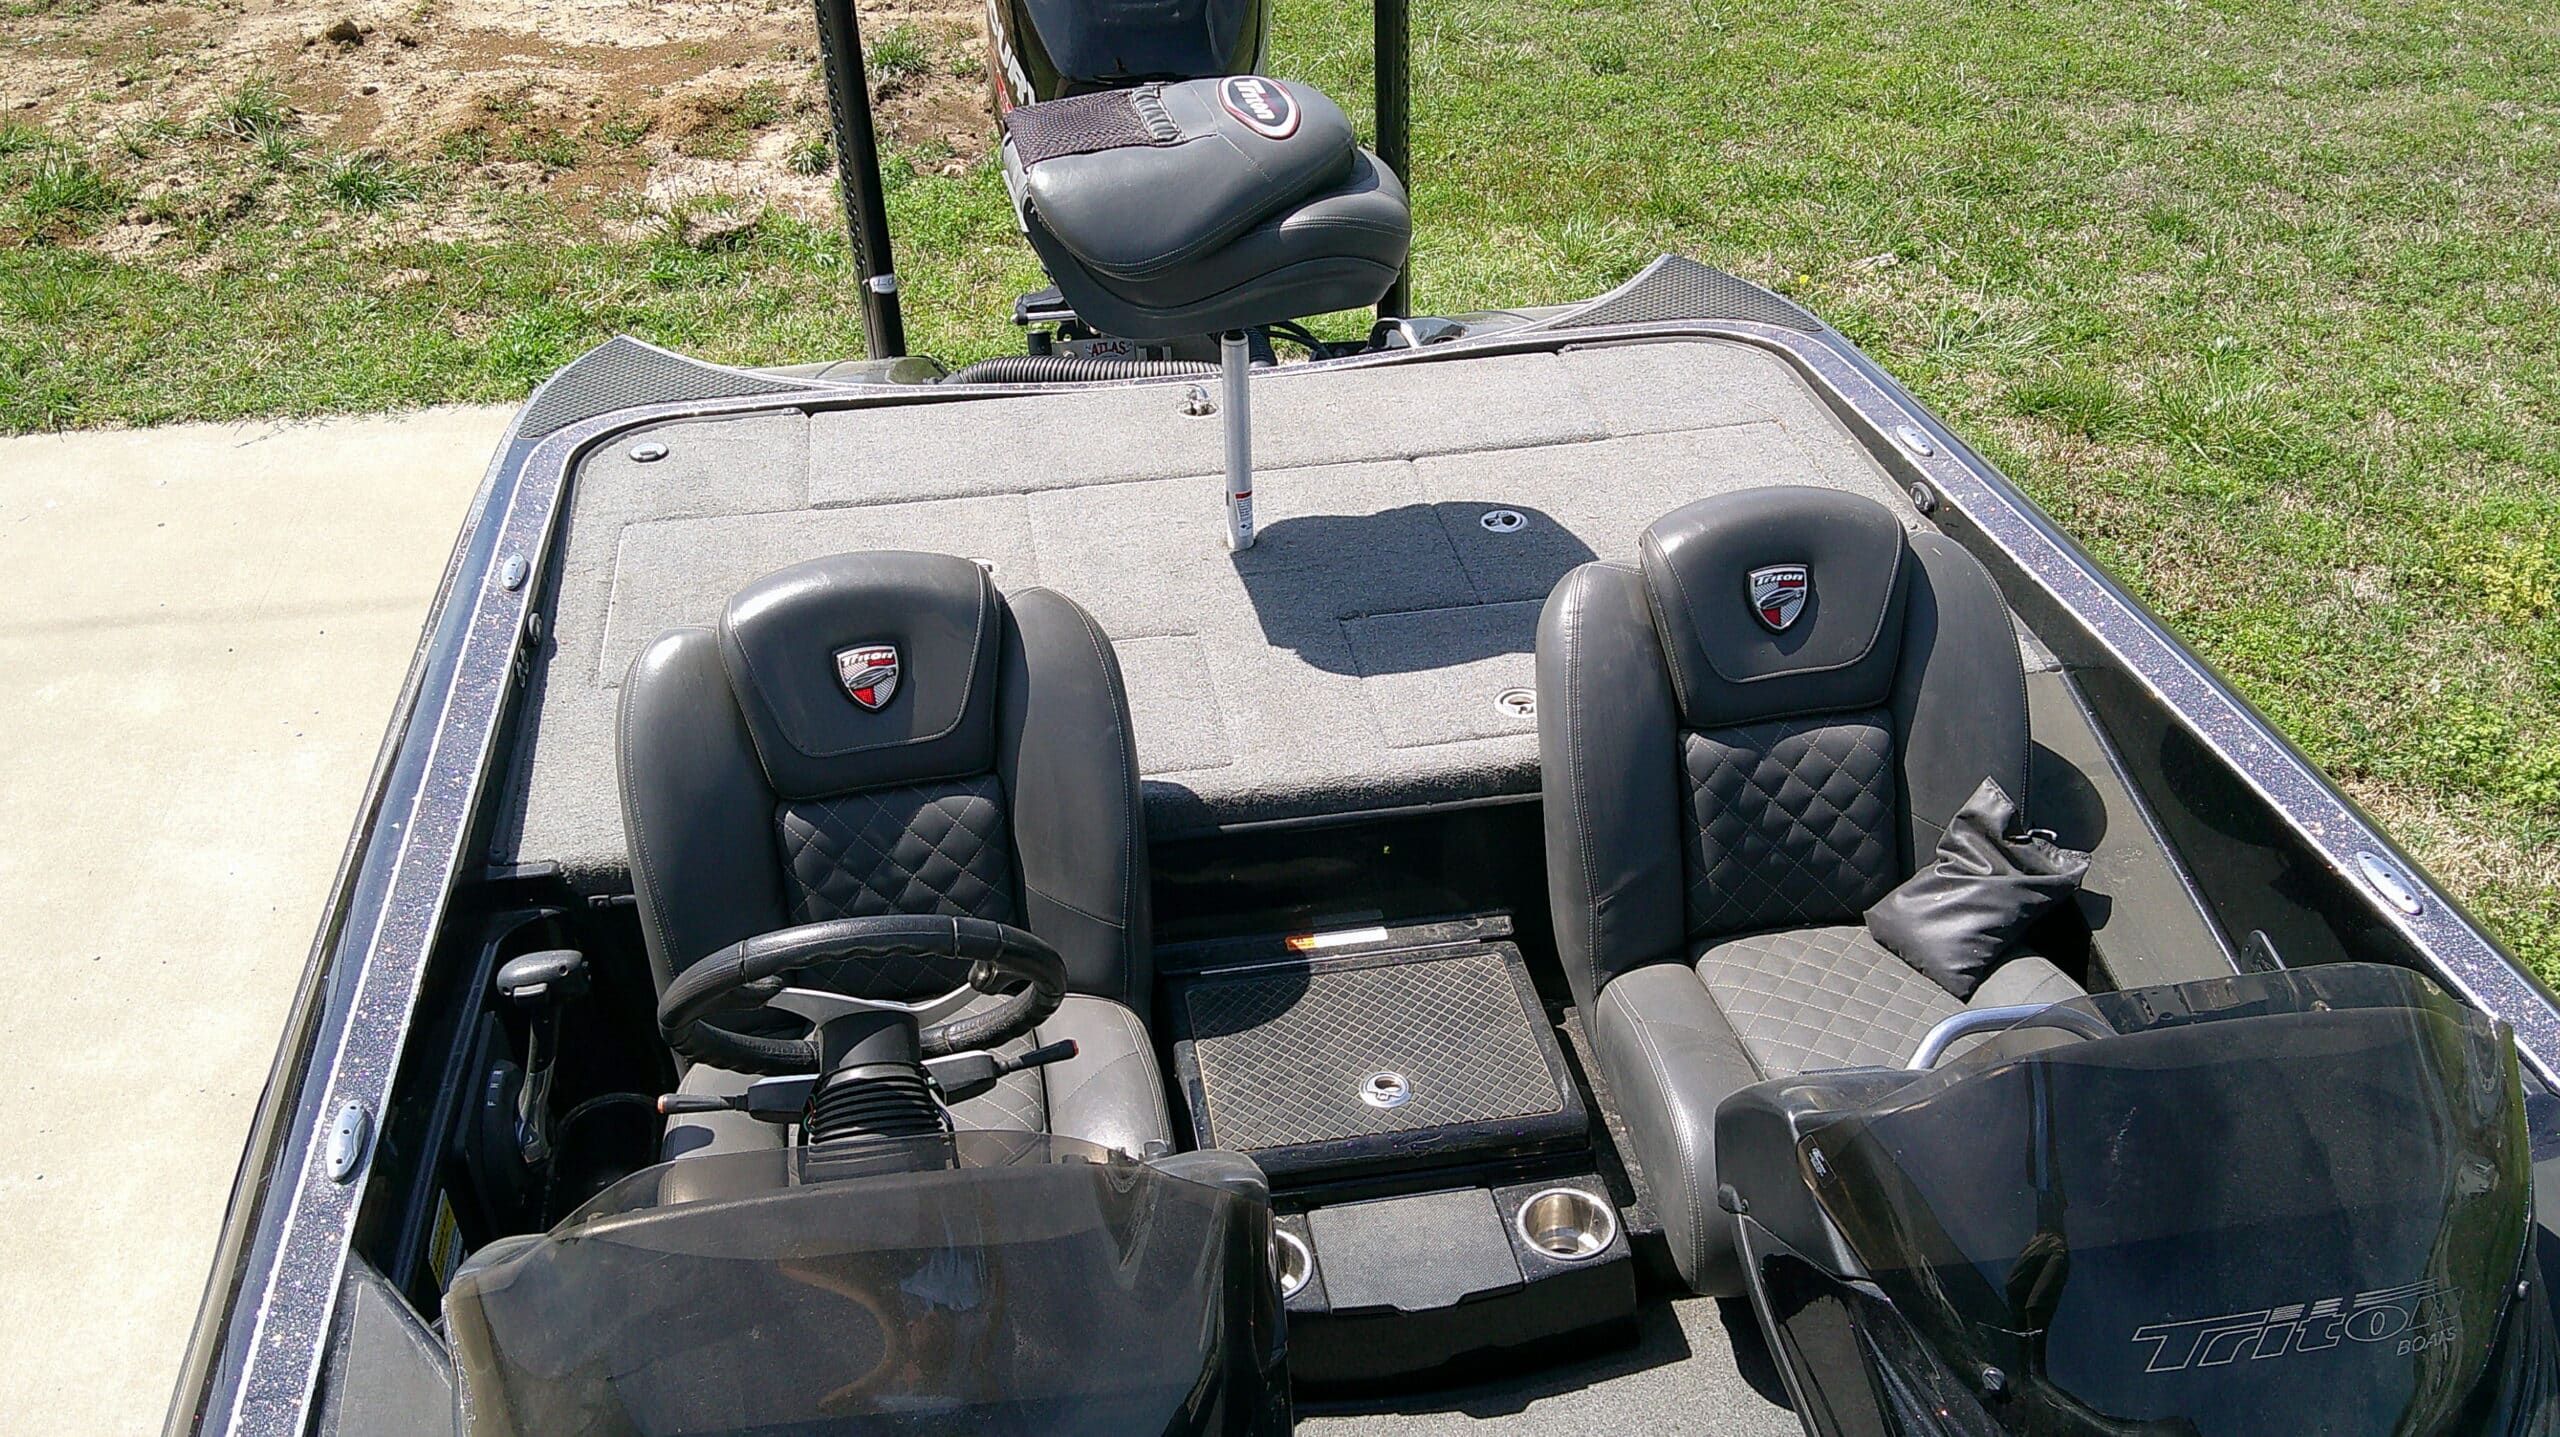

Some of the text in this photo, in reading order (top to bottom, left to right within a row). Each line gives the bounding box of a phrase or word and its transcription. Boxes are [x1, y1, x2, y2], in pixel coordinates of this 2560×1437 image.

[1091, 341, 1126, 357] ATLAS
[1756, 573, 1803, 585] Triton
[841, 652, 893, 666] Triton
[2397, 1326, 2457, 1356] BOATS
